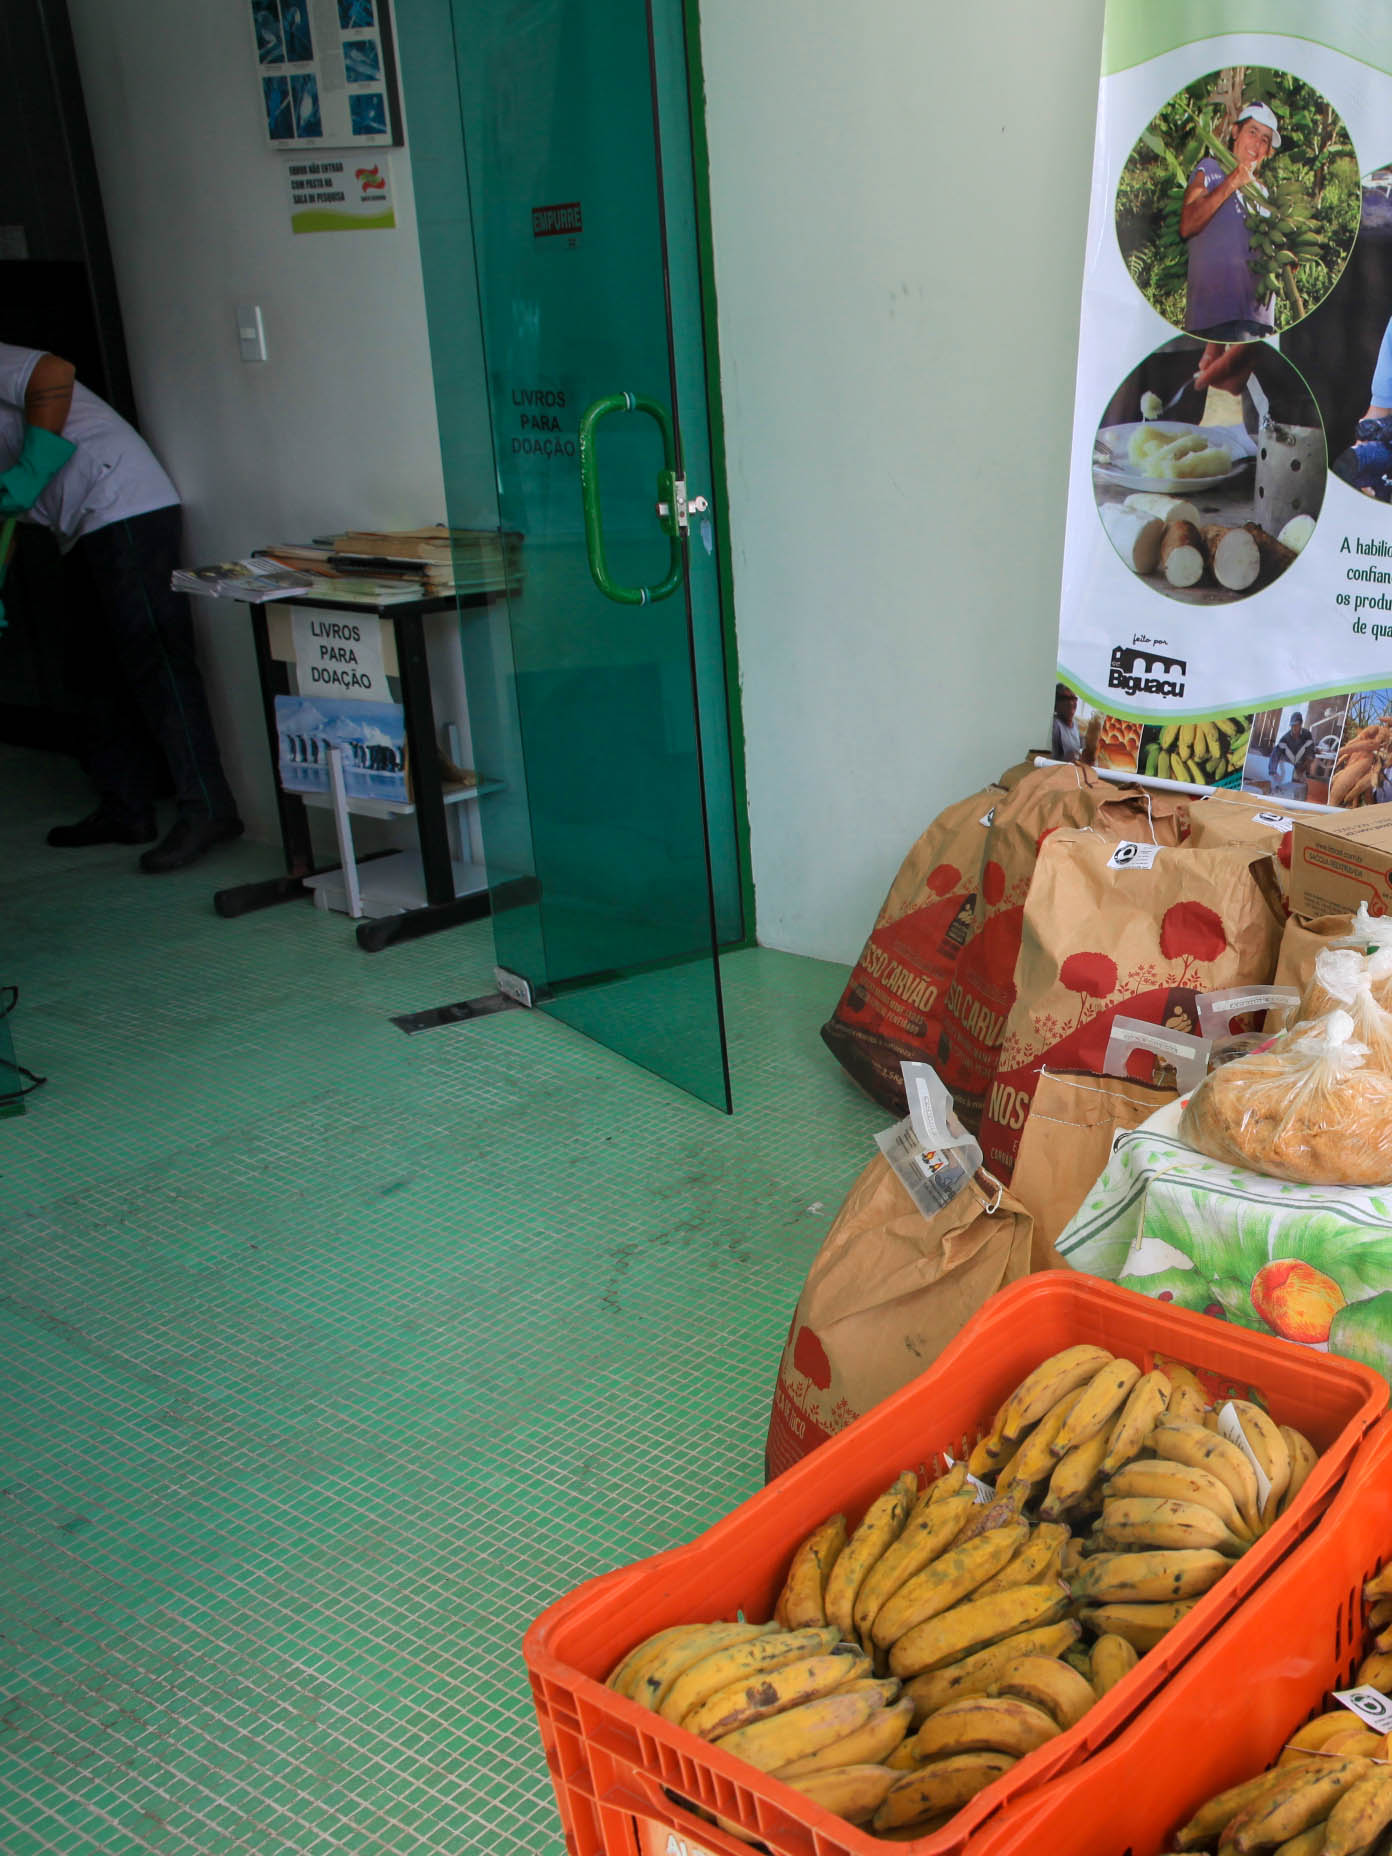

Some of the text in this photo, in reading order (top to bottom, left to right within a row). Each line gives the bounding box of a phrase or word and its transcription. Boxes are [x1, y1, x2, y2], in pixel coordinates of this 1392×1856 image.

[535, 206, 581, 233] EMPURRE
[512, 389, 566, 408] LIVROS
[520, 414, 562, 432] PARA
[512, 436, 576, 460] DOAÇÃO
[1340, 536, 1351, 554] A
[1336, 593, 1350, 605] os
[311, 621, 360, 641] LIVROS
[1353, 617, 1367, 634] de
[1133, 633, 1168, 647] feito por
[320, 645, 358, 664] PARA
[311, 667, 371, 690] DOAÇÃO
[1108, 668, 1185, 699] Biguaçu
[863, 940, 889, 978] SSO
[881, 961, 938, 1012] CARVÃO
[988, 1081, 1031, 1130] NOS
